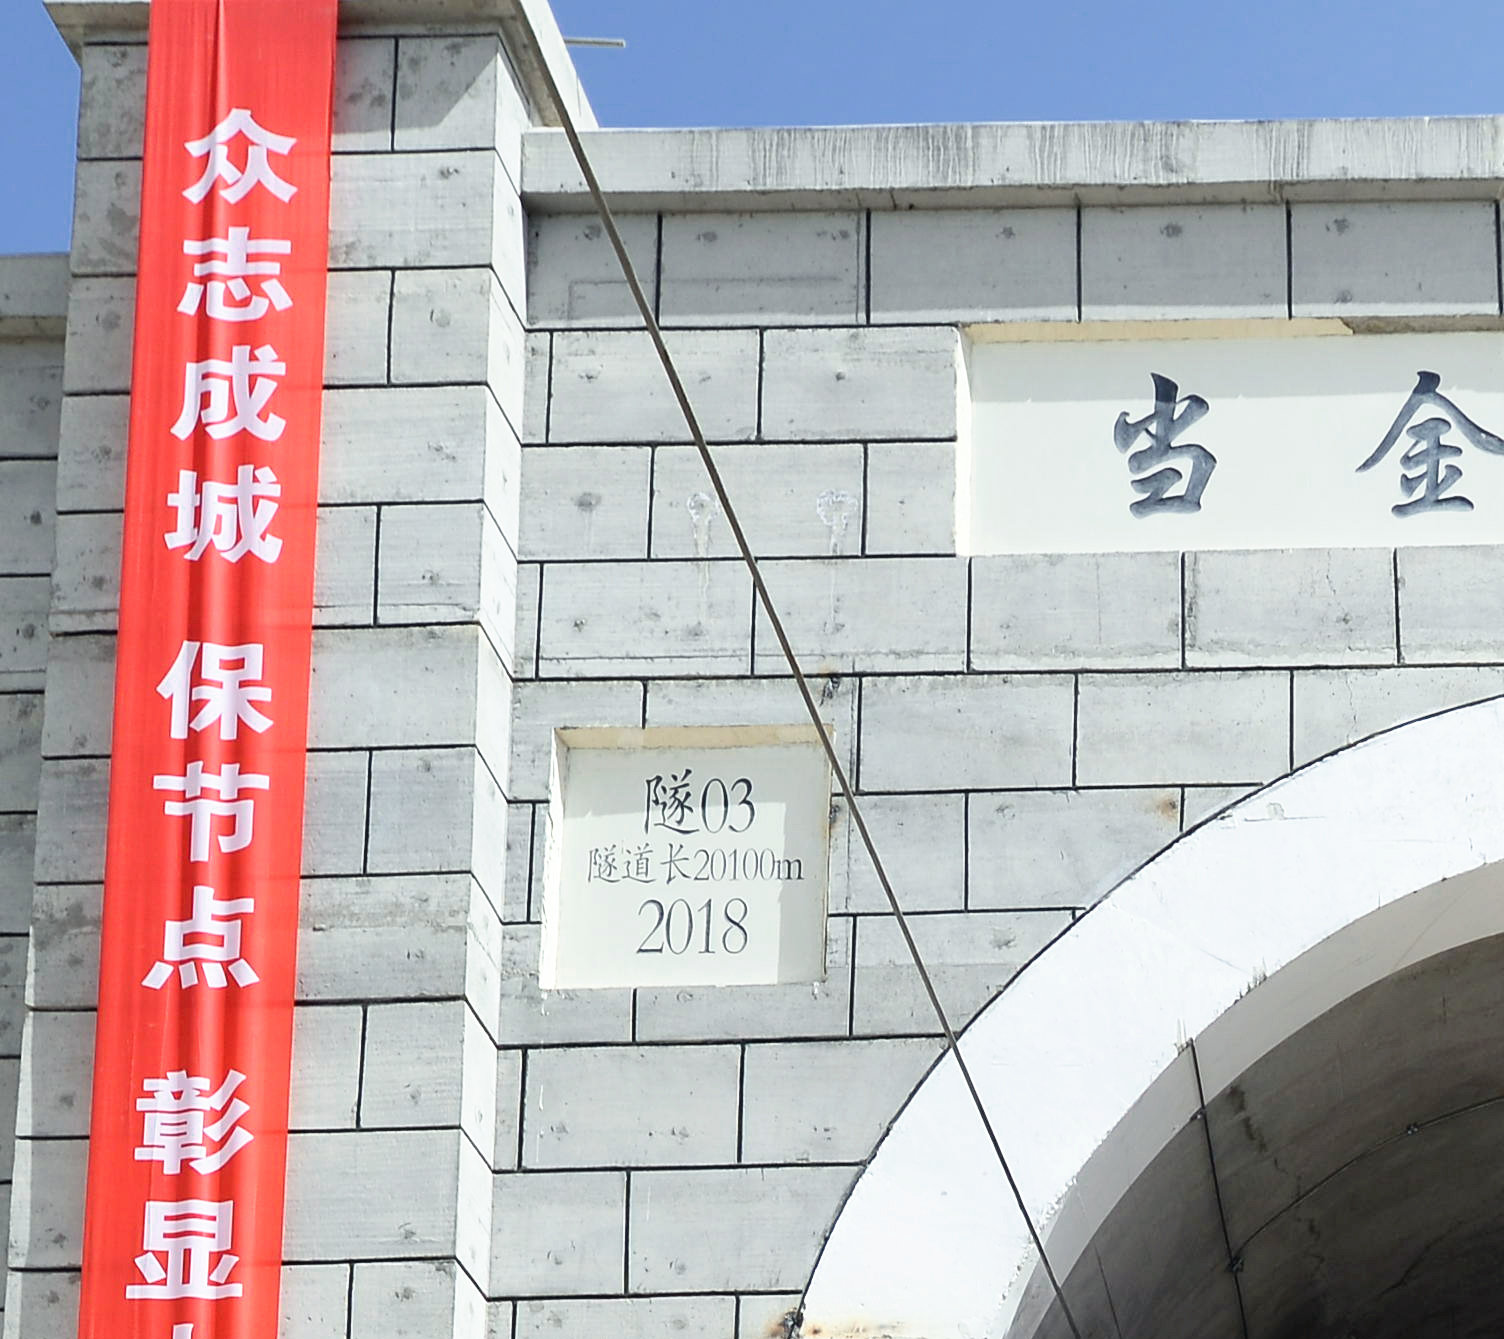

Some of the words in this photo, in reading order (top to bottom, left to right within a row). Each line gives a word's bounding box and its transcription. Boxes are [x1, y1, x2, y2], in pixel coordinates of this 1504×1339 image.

[163, 106, 299, 566] 众志成城
[140, 638, 275, 991] 保节点
[644, 767, 757, 835] 隧03
[586, 842, 806, 885] 隧道长20100m
[635, 897, 749, 956] 2018
